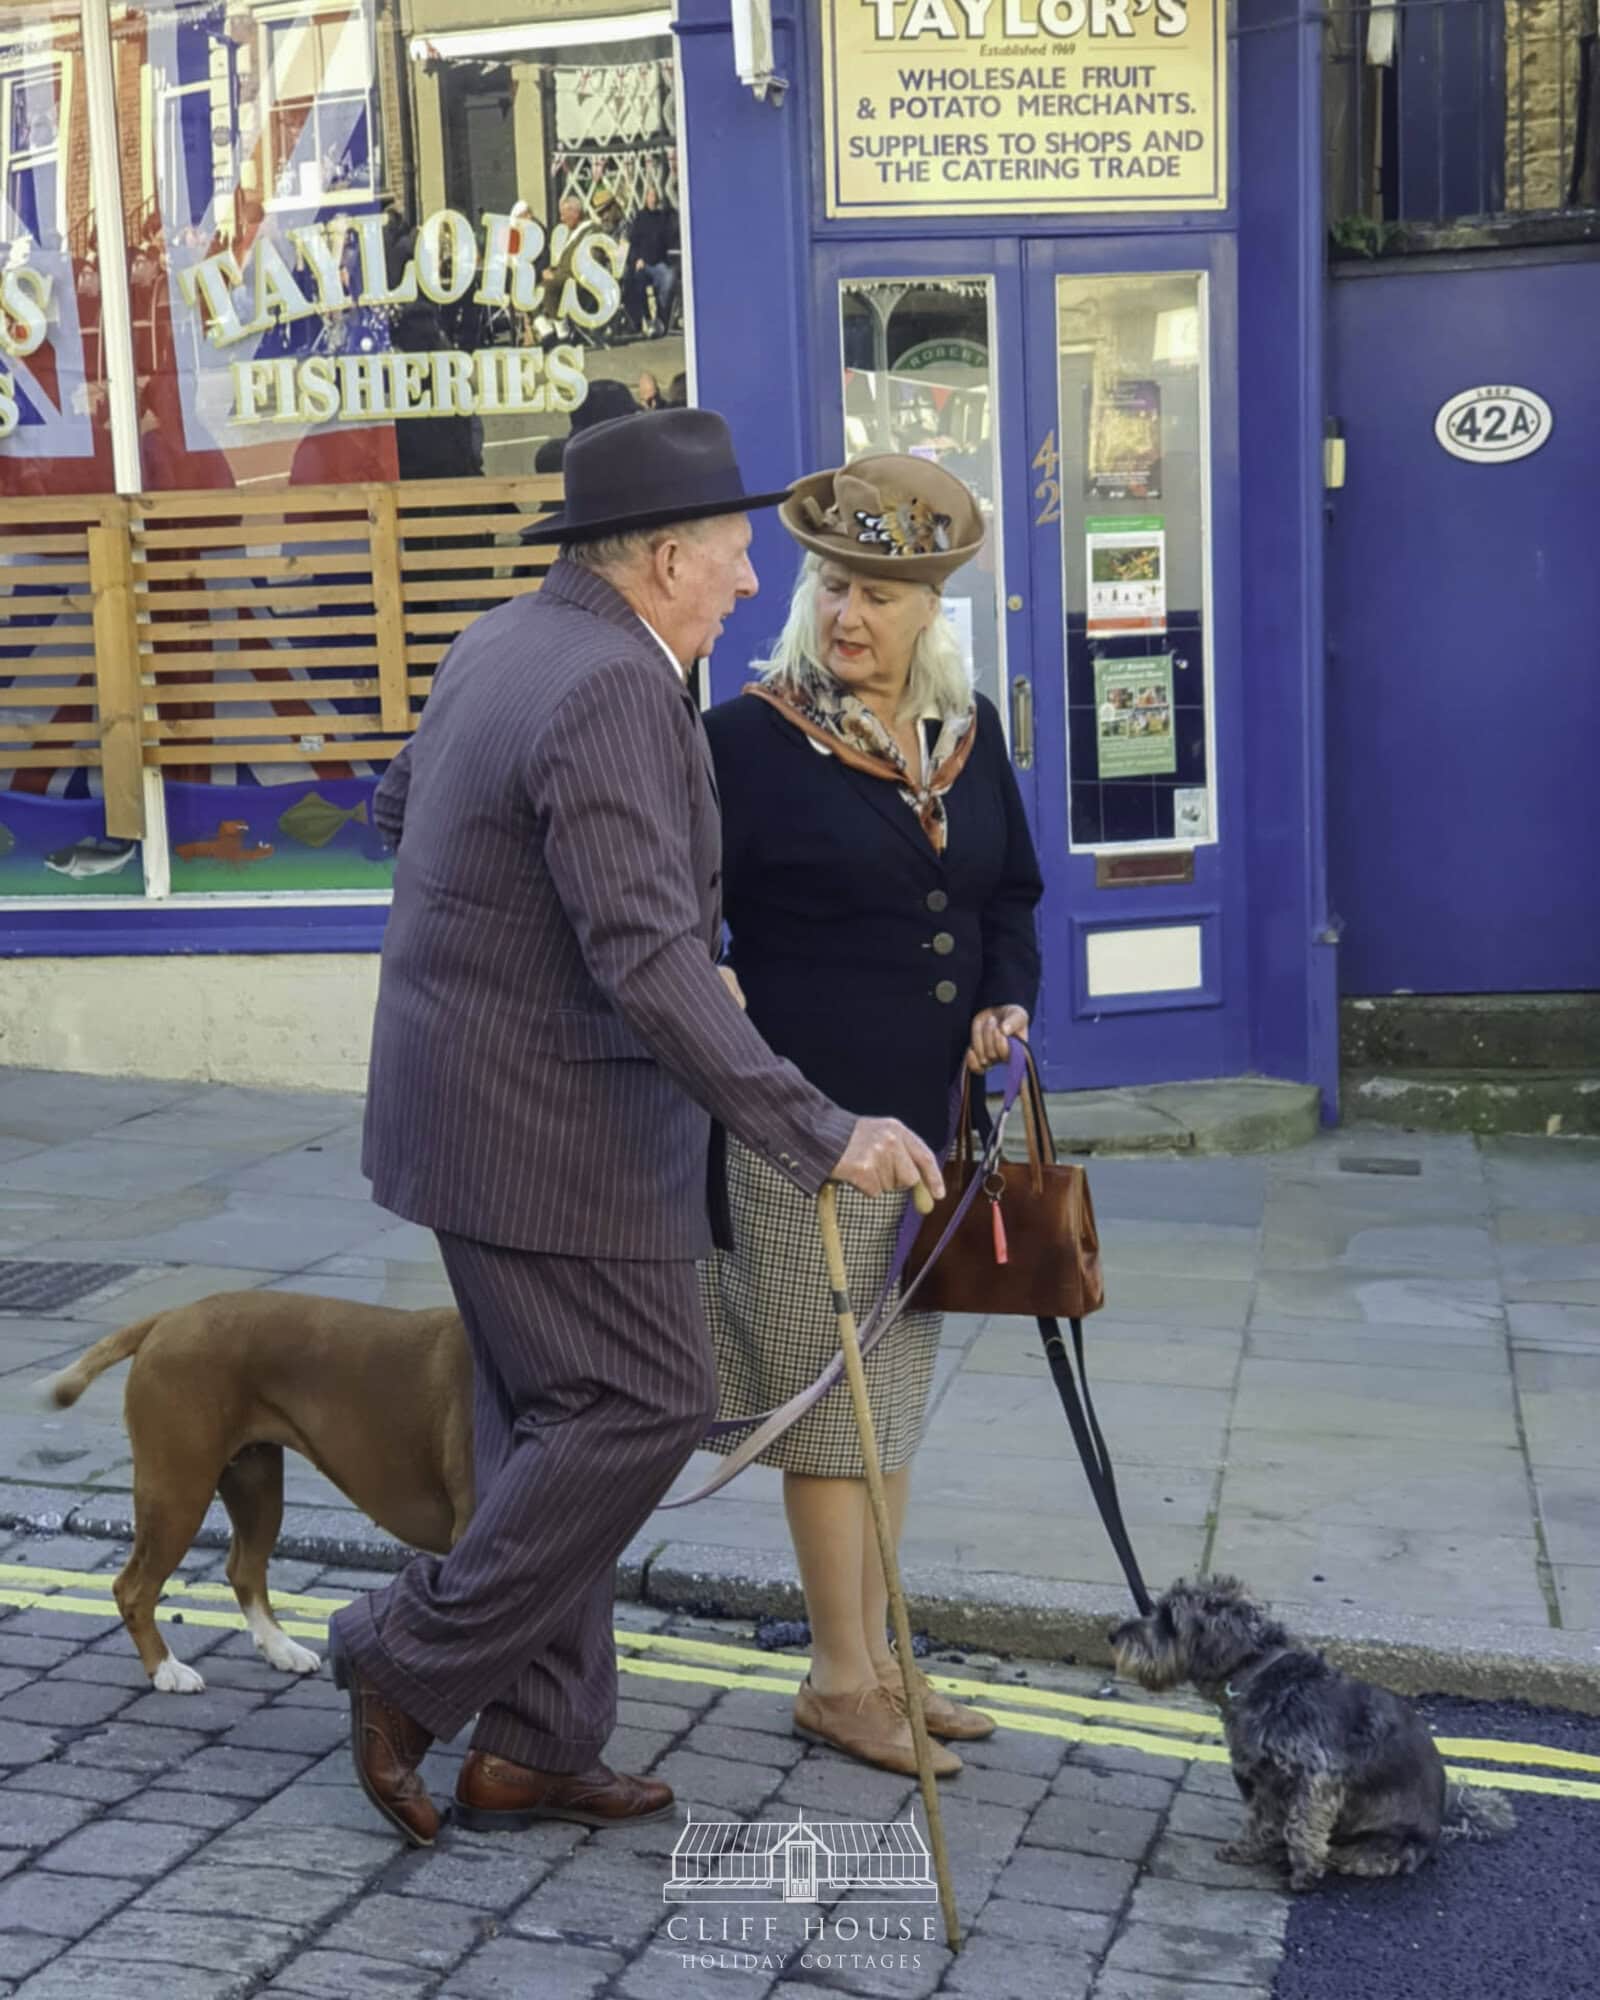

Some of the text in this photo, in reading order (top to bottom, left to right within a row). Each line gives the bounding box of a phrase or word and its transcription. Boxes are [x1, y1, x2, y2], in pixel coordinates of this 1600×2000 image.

[860, 0, 1188, 40] TAYLOR'S
[979, 43, 1076, 57] Established 1969
[898, 66, 1156, 92] WHOLESALE FRUIT
[856, 93, 1196, 119] & POTATO MERCHANTS.
[849, 130, 1204, 157] SUPPLIERS TO SHOPS AND
[875, 156, 1181, 183] THE CATERING TRADE
[177, 209, 630, 348] TAYLOR'S
[230, 345, 589, 425] FISHERIES
[1455, 406, 1531, 443] 42A
